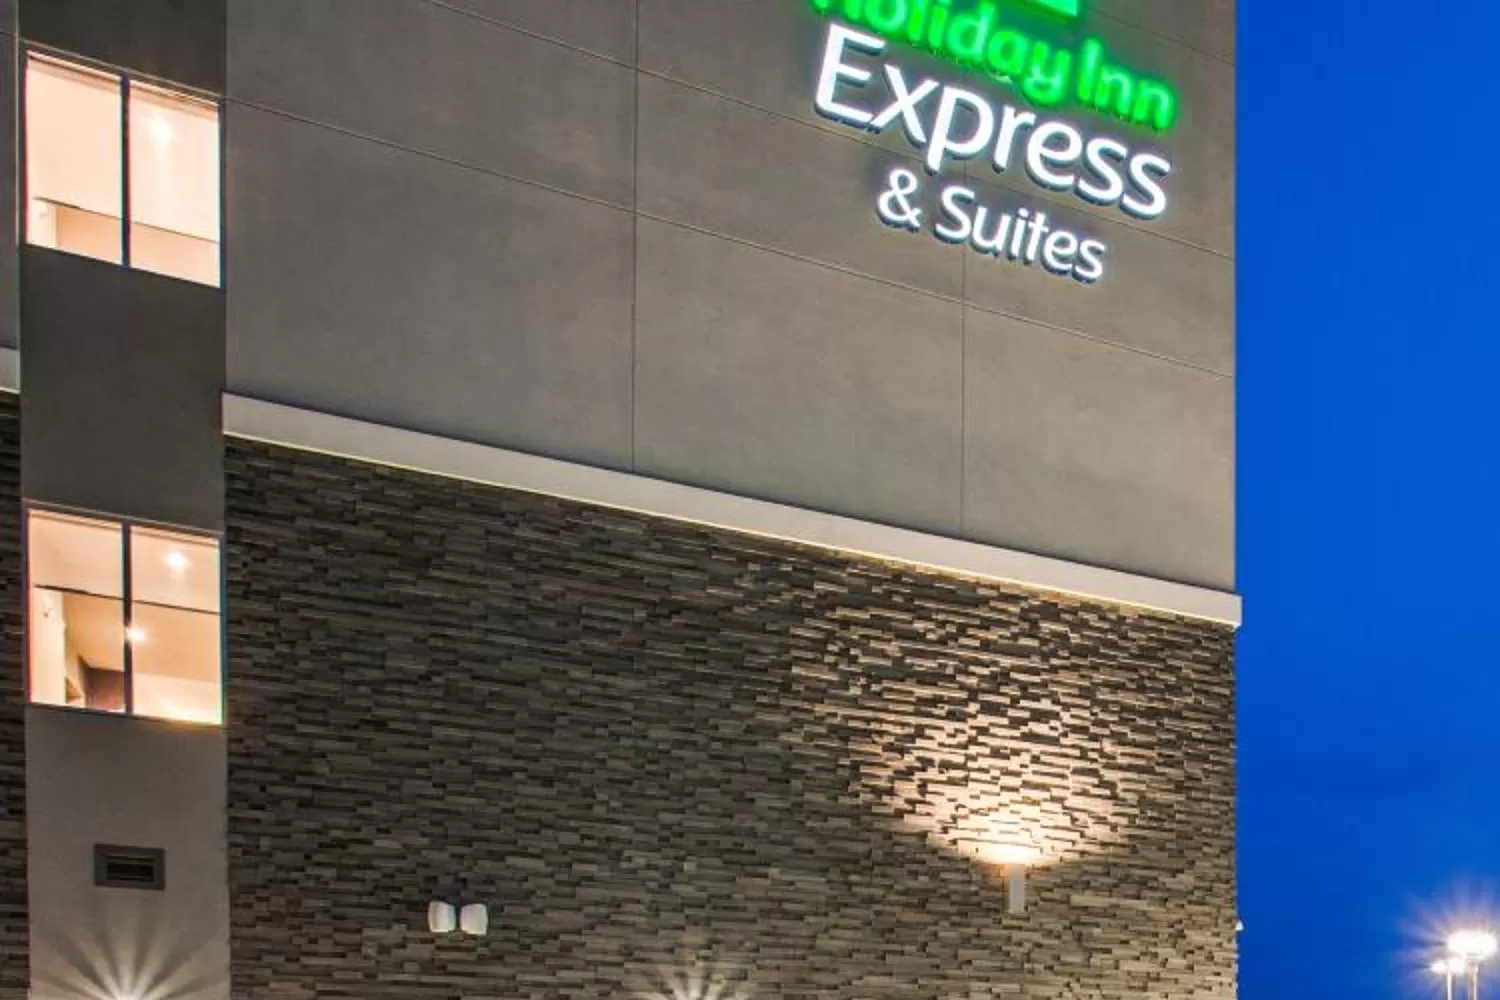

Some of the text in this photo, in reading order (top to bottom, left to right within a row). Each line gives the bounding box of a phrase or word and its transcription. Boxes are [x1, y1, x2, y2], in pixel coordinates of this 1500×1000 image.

[815, 22, 1172, 219] Express
[1076, 37, 1177, 131] Inn
[876, 167, 1105, 283] & Suites
